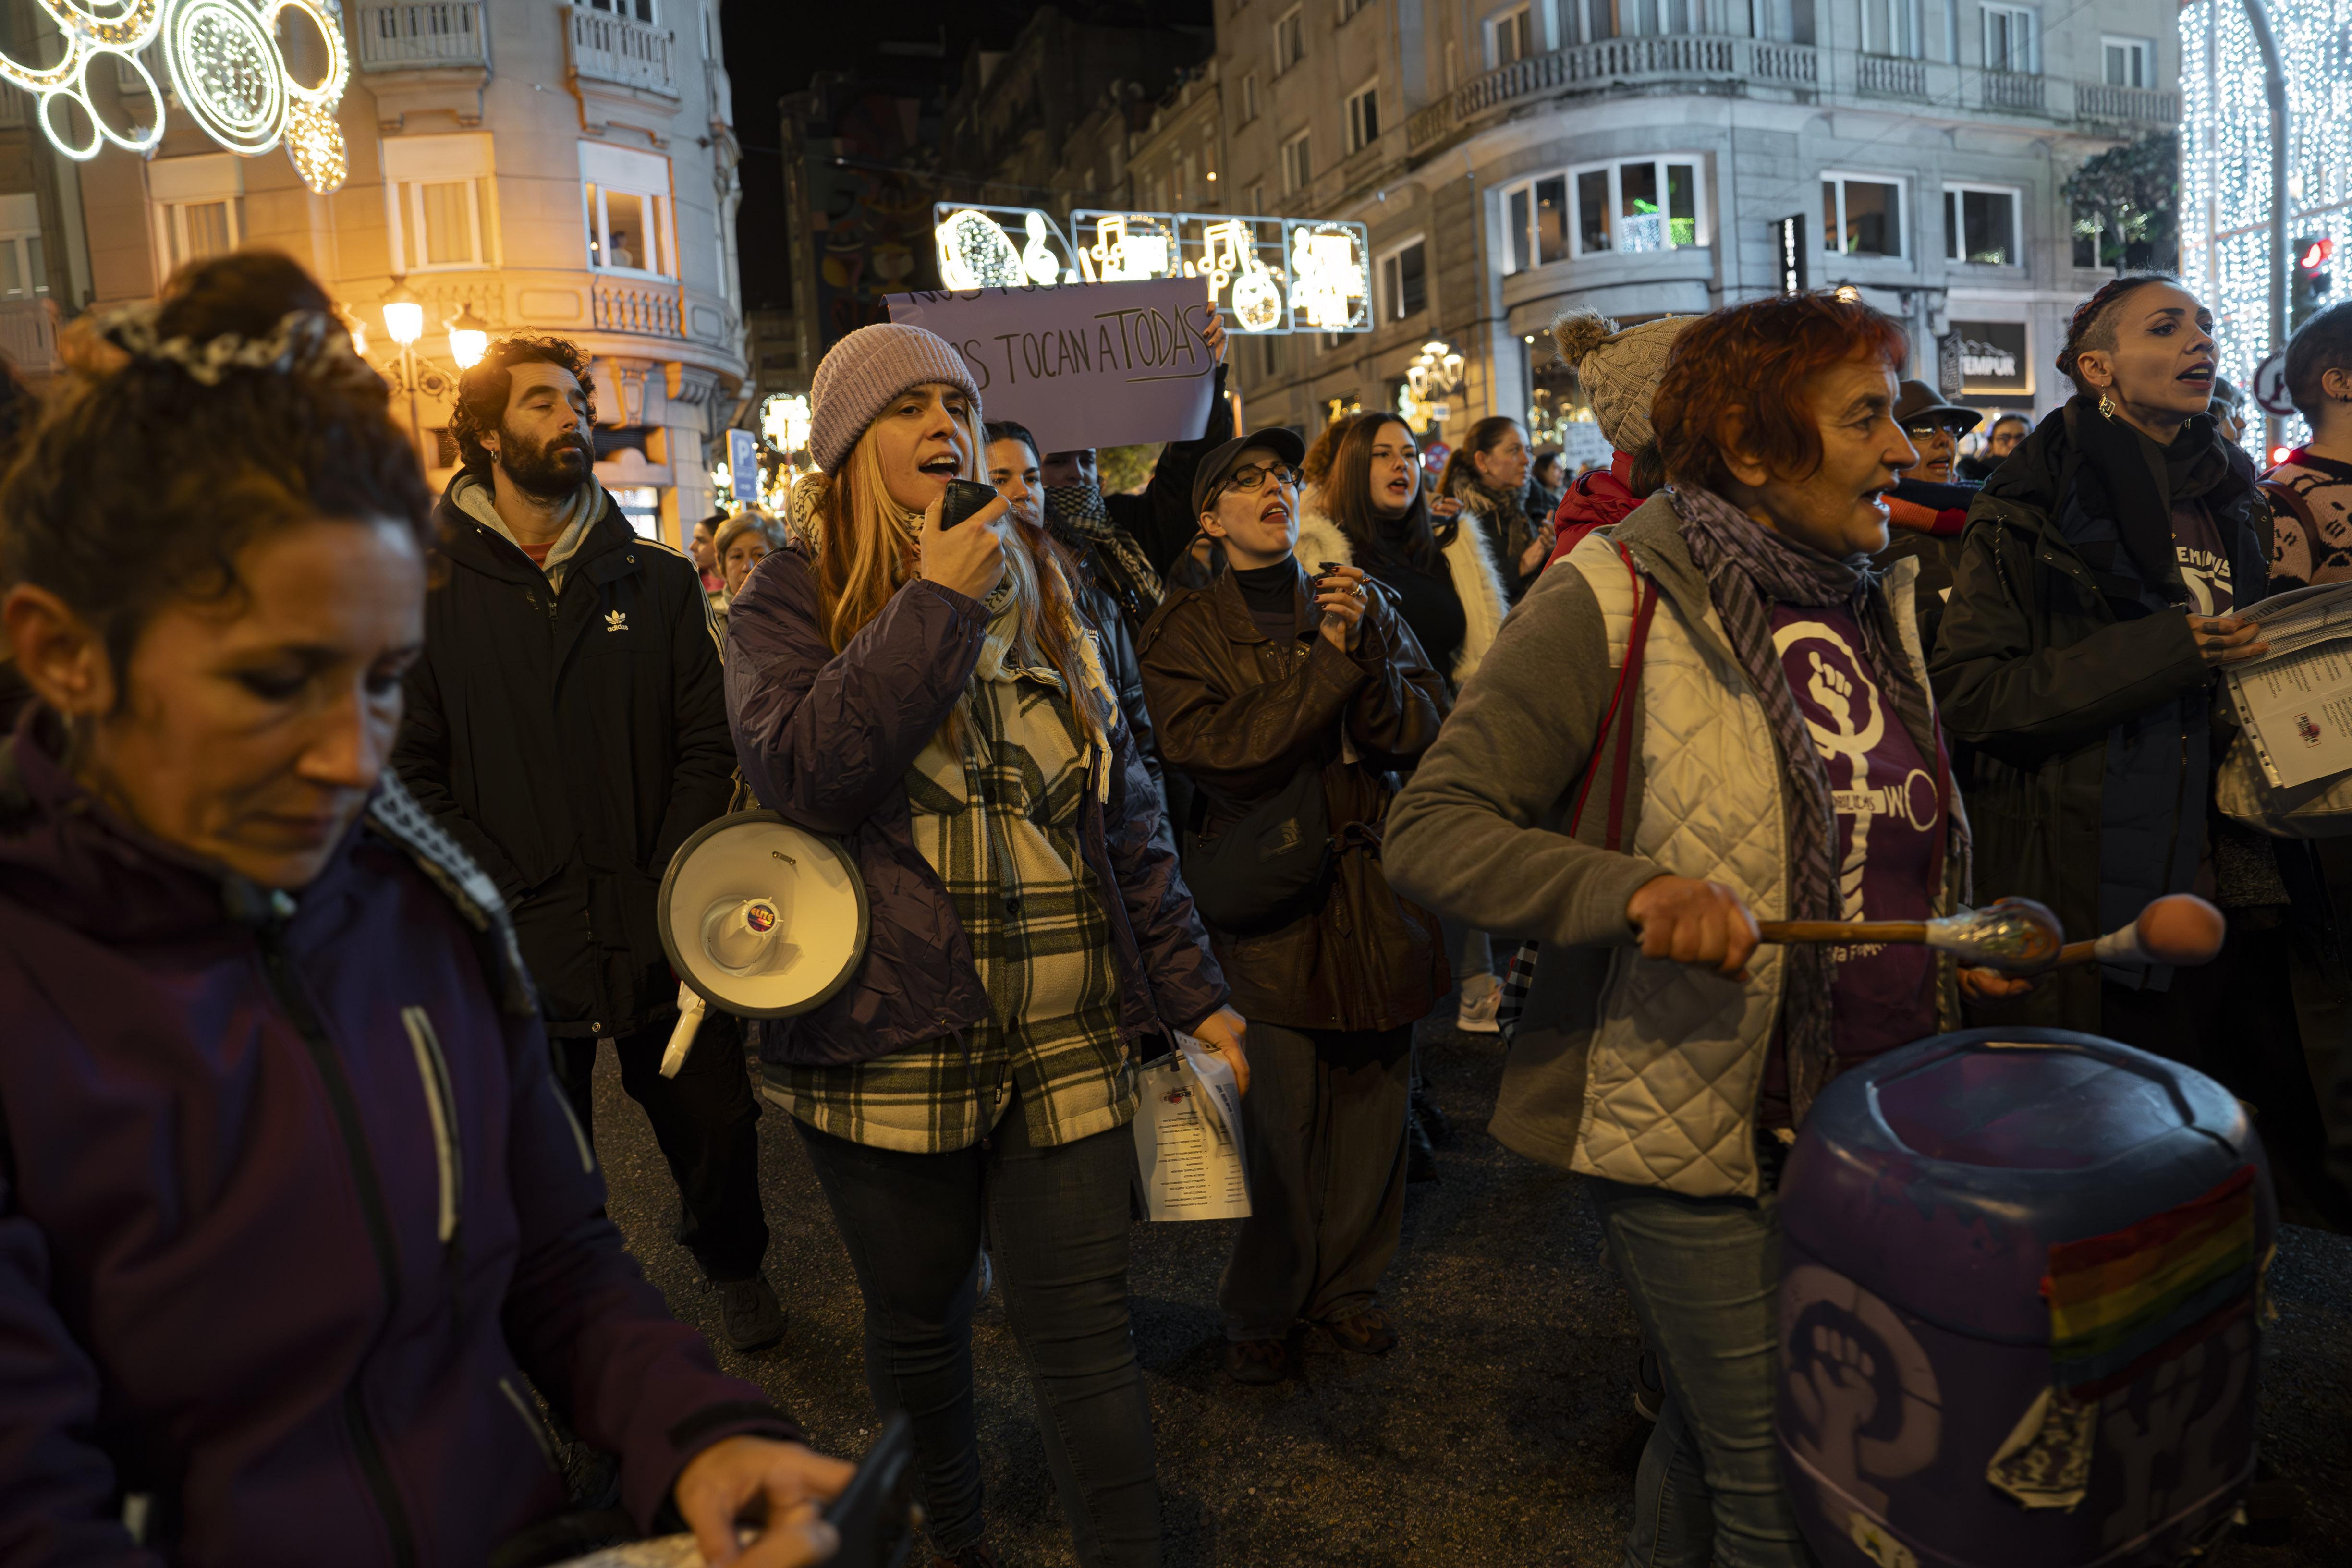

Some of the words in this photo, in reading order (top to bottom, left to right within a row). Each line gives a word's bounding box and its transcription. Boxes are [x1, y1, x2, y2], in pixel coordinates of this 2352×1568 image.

[994, 328, 1090, 384] TOCAN
[1094, 304, 1213, 382] TODAS
[1099, 324, 1118, 373] A
[737, 439, 750, 466] P
[2176, 547, 2231, 577] EMINIS
